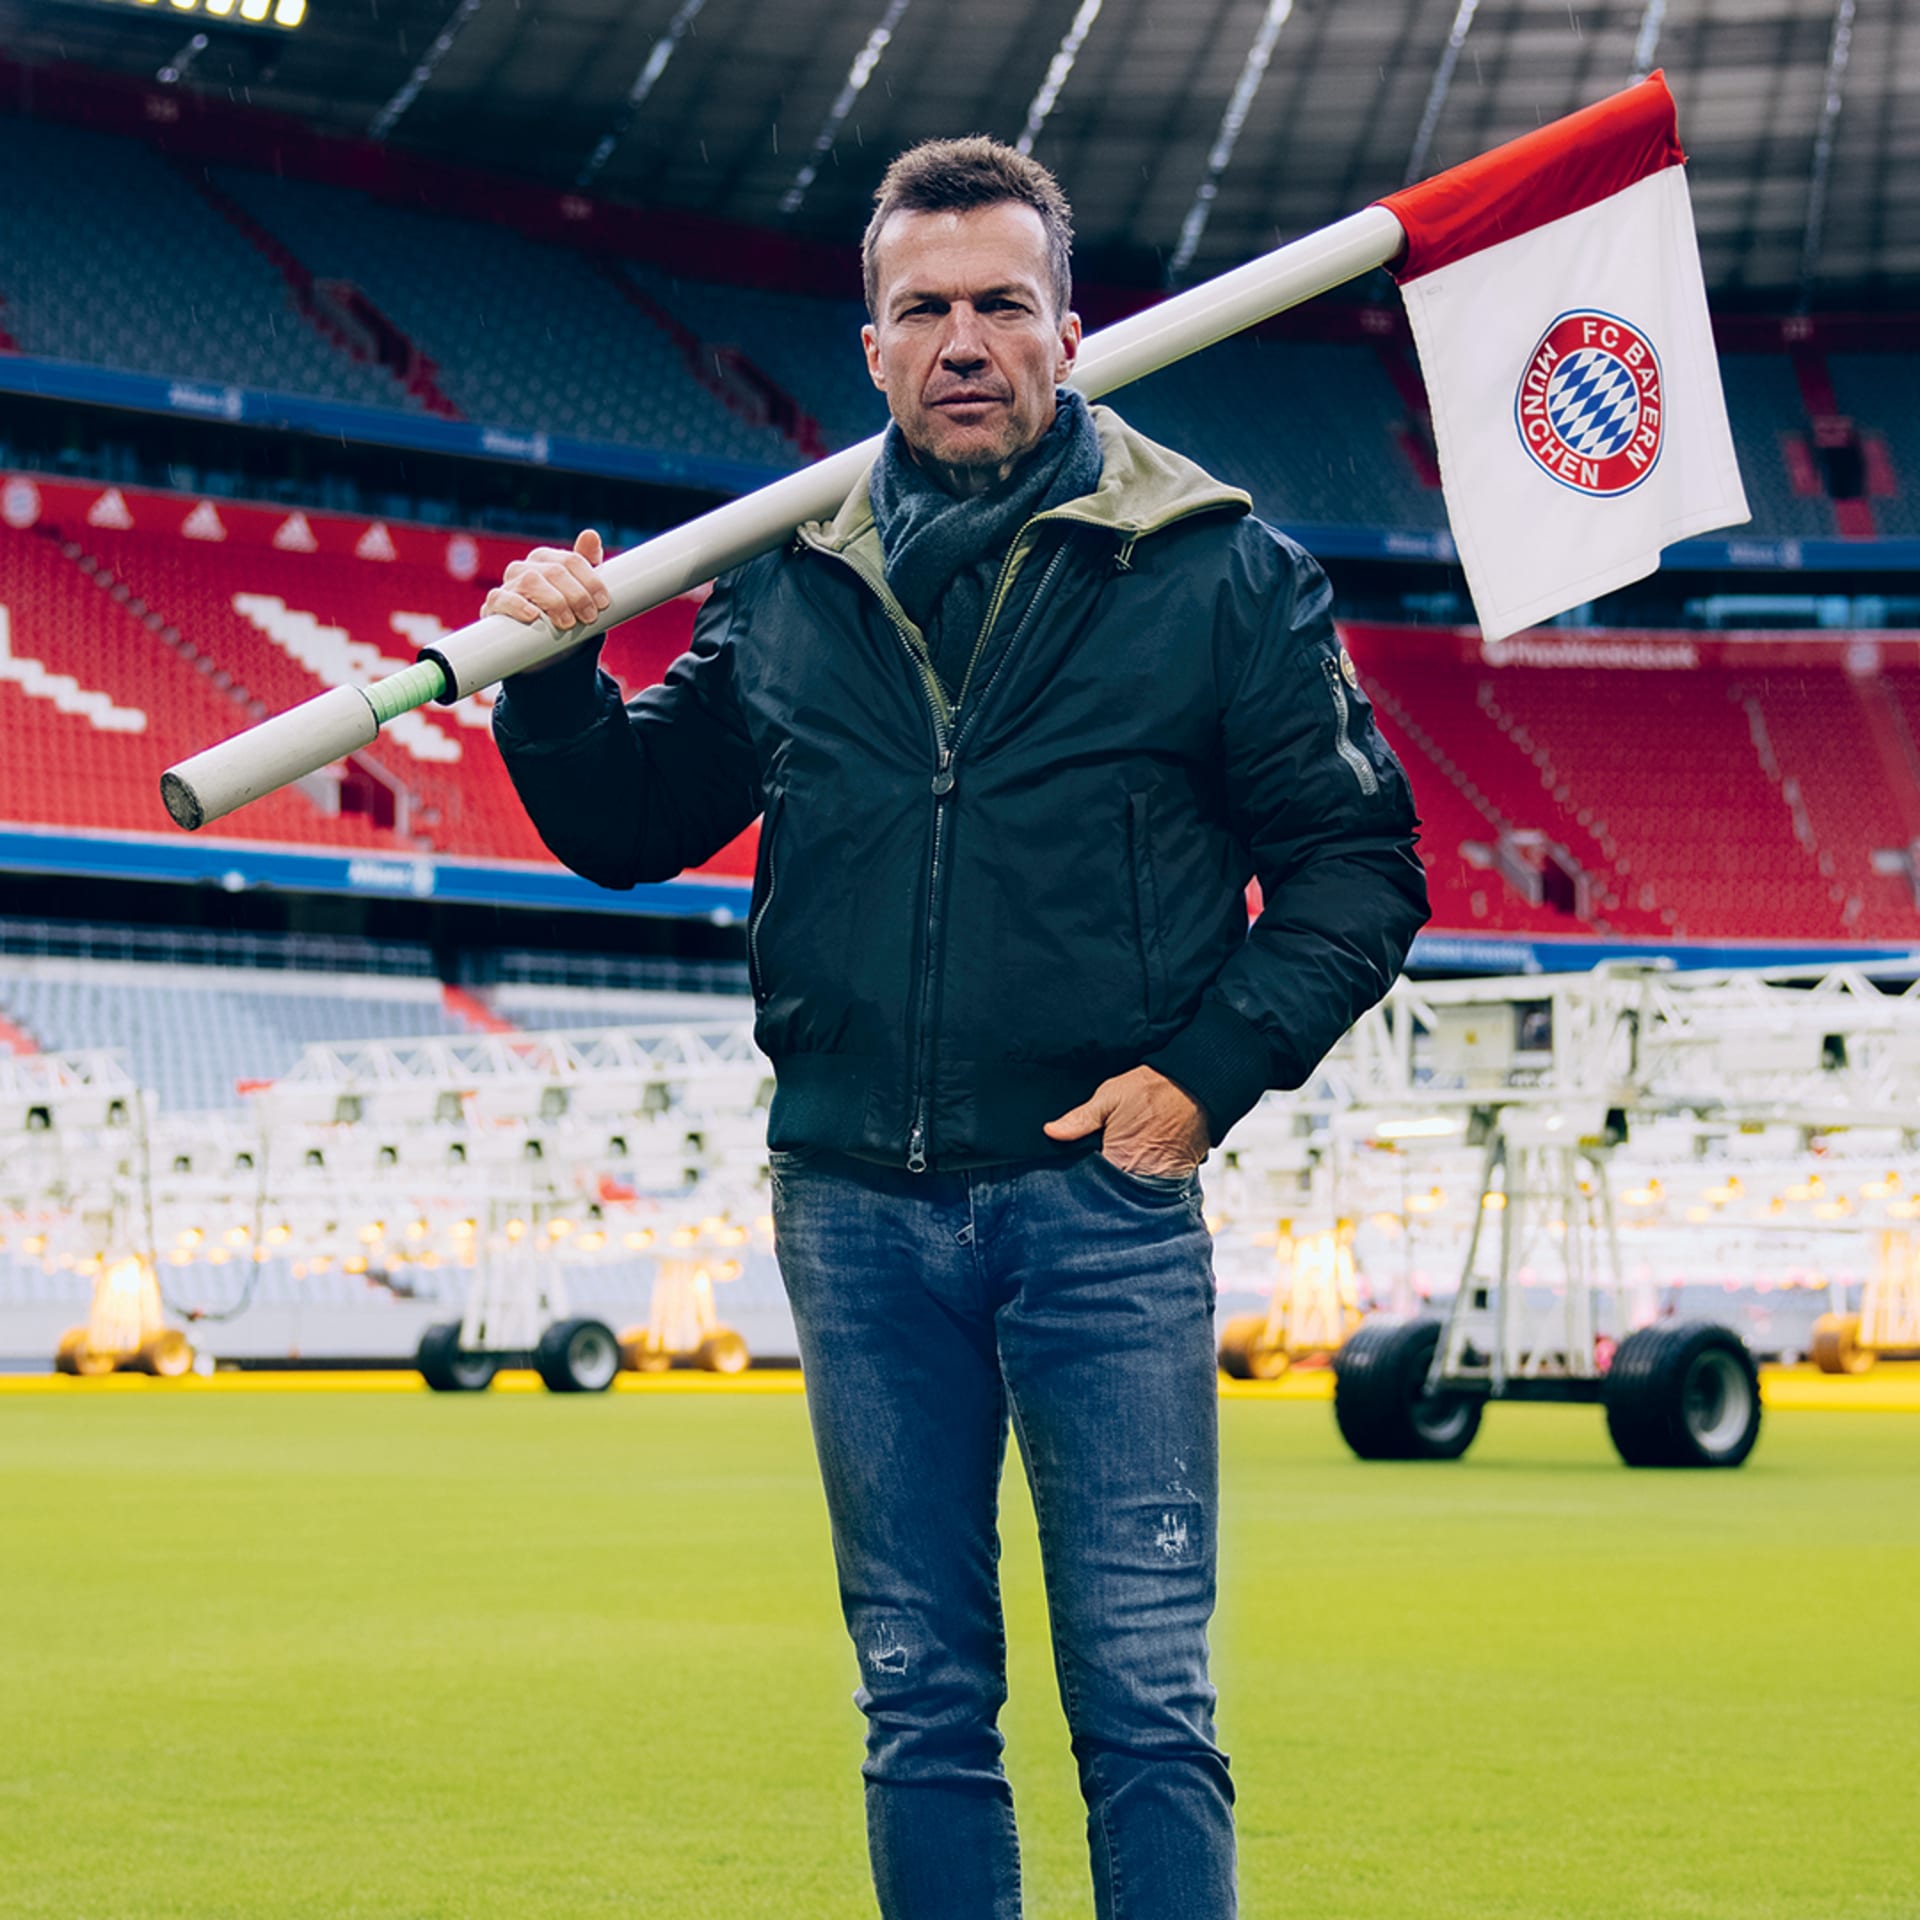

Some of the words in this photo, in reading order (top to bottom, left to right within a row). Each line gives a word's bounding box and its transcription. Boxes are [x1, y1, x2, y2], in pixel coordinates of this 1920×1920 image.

[1523, 341, 1599, 487] MÜNCHEN
[1583, 321, 1620, 348] FC
[1623, 341, 1660, 469] BAYERN
